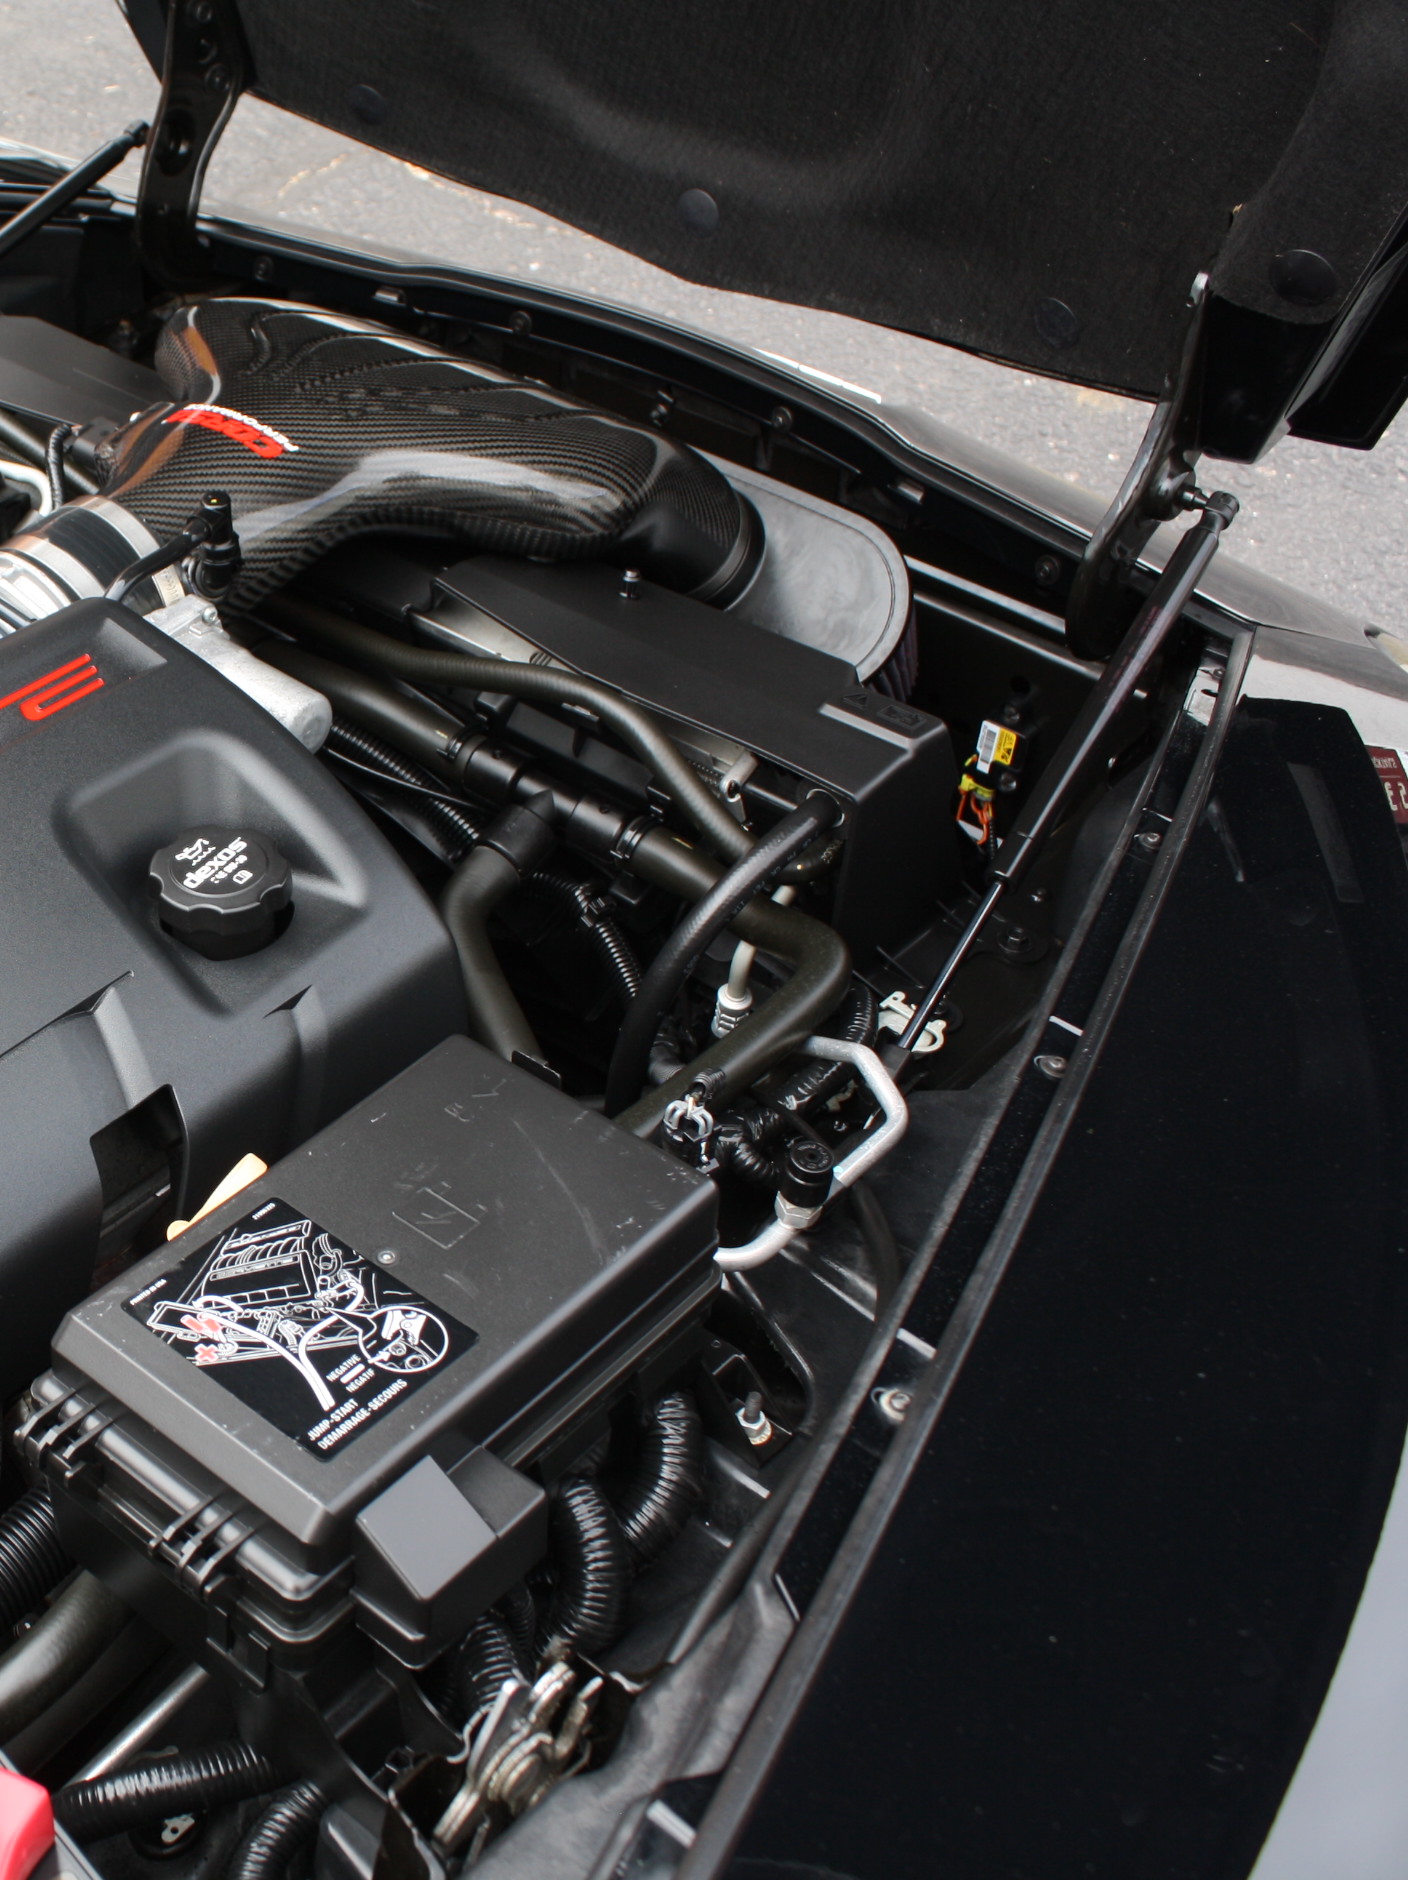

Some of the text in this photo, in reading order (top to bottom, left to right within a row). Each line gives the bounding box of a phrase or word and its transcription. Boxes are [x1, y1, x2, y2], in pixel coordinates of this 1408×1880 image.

[183, 837, 247, 888] dexos
[326, 1354, 361, 1382] NEGATIVE
[345, 1368, 375, 1393] NEGATIF
[307, 1398, 358, 1441] JUMP-START
[317, 1379, 408, 1450] DEMARRAGE-SECOURS
